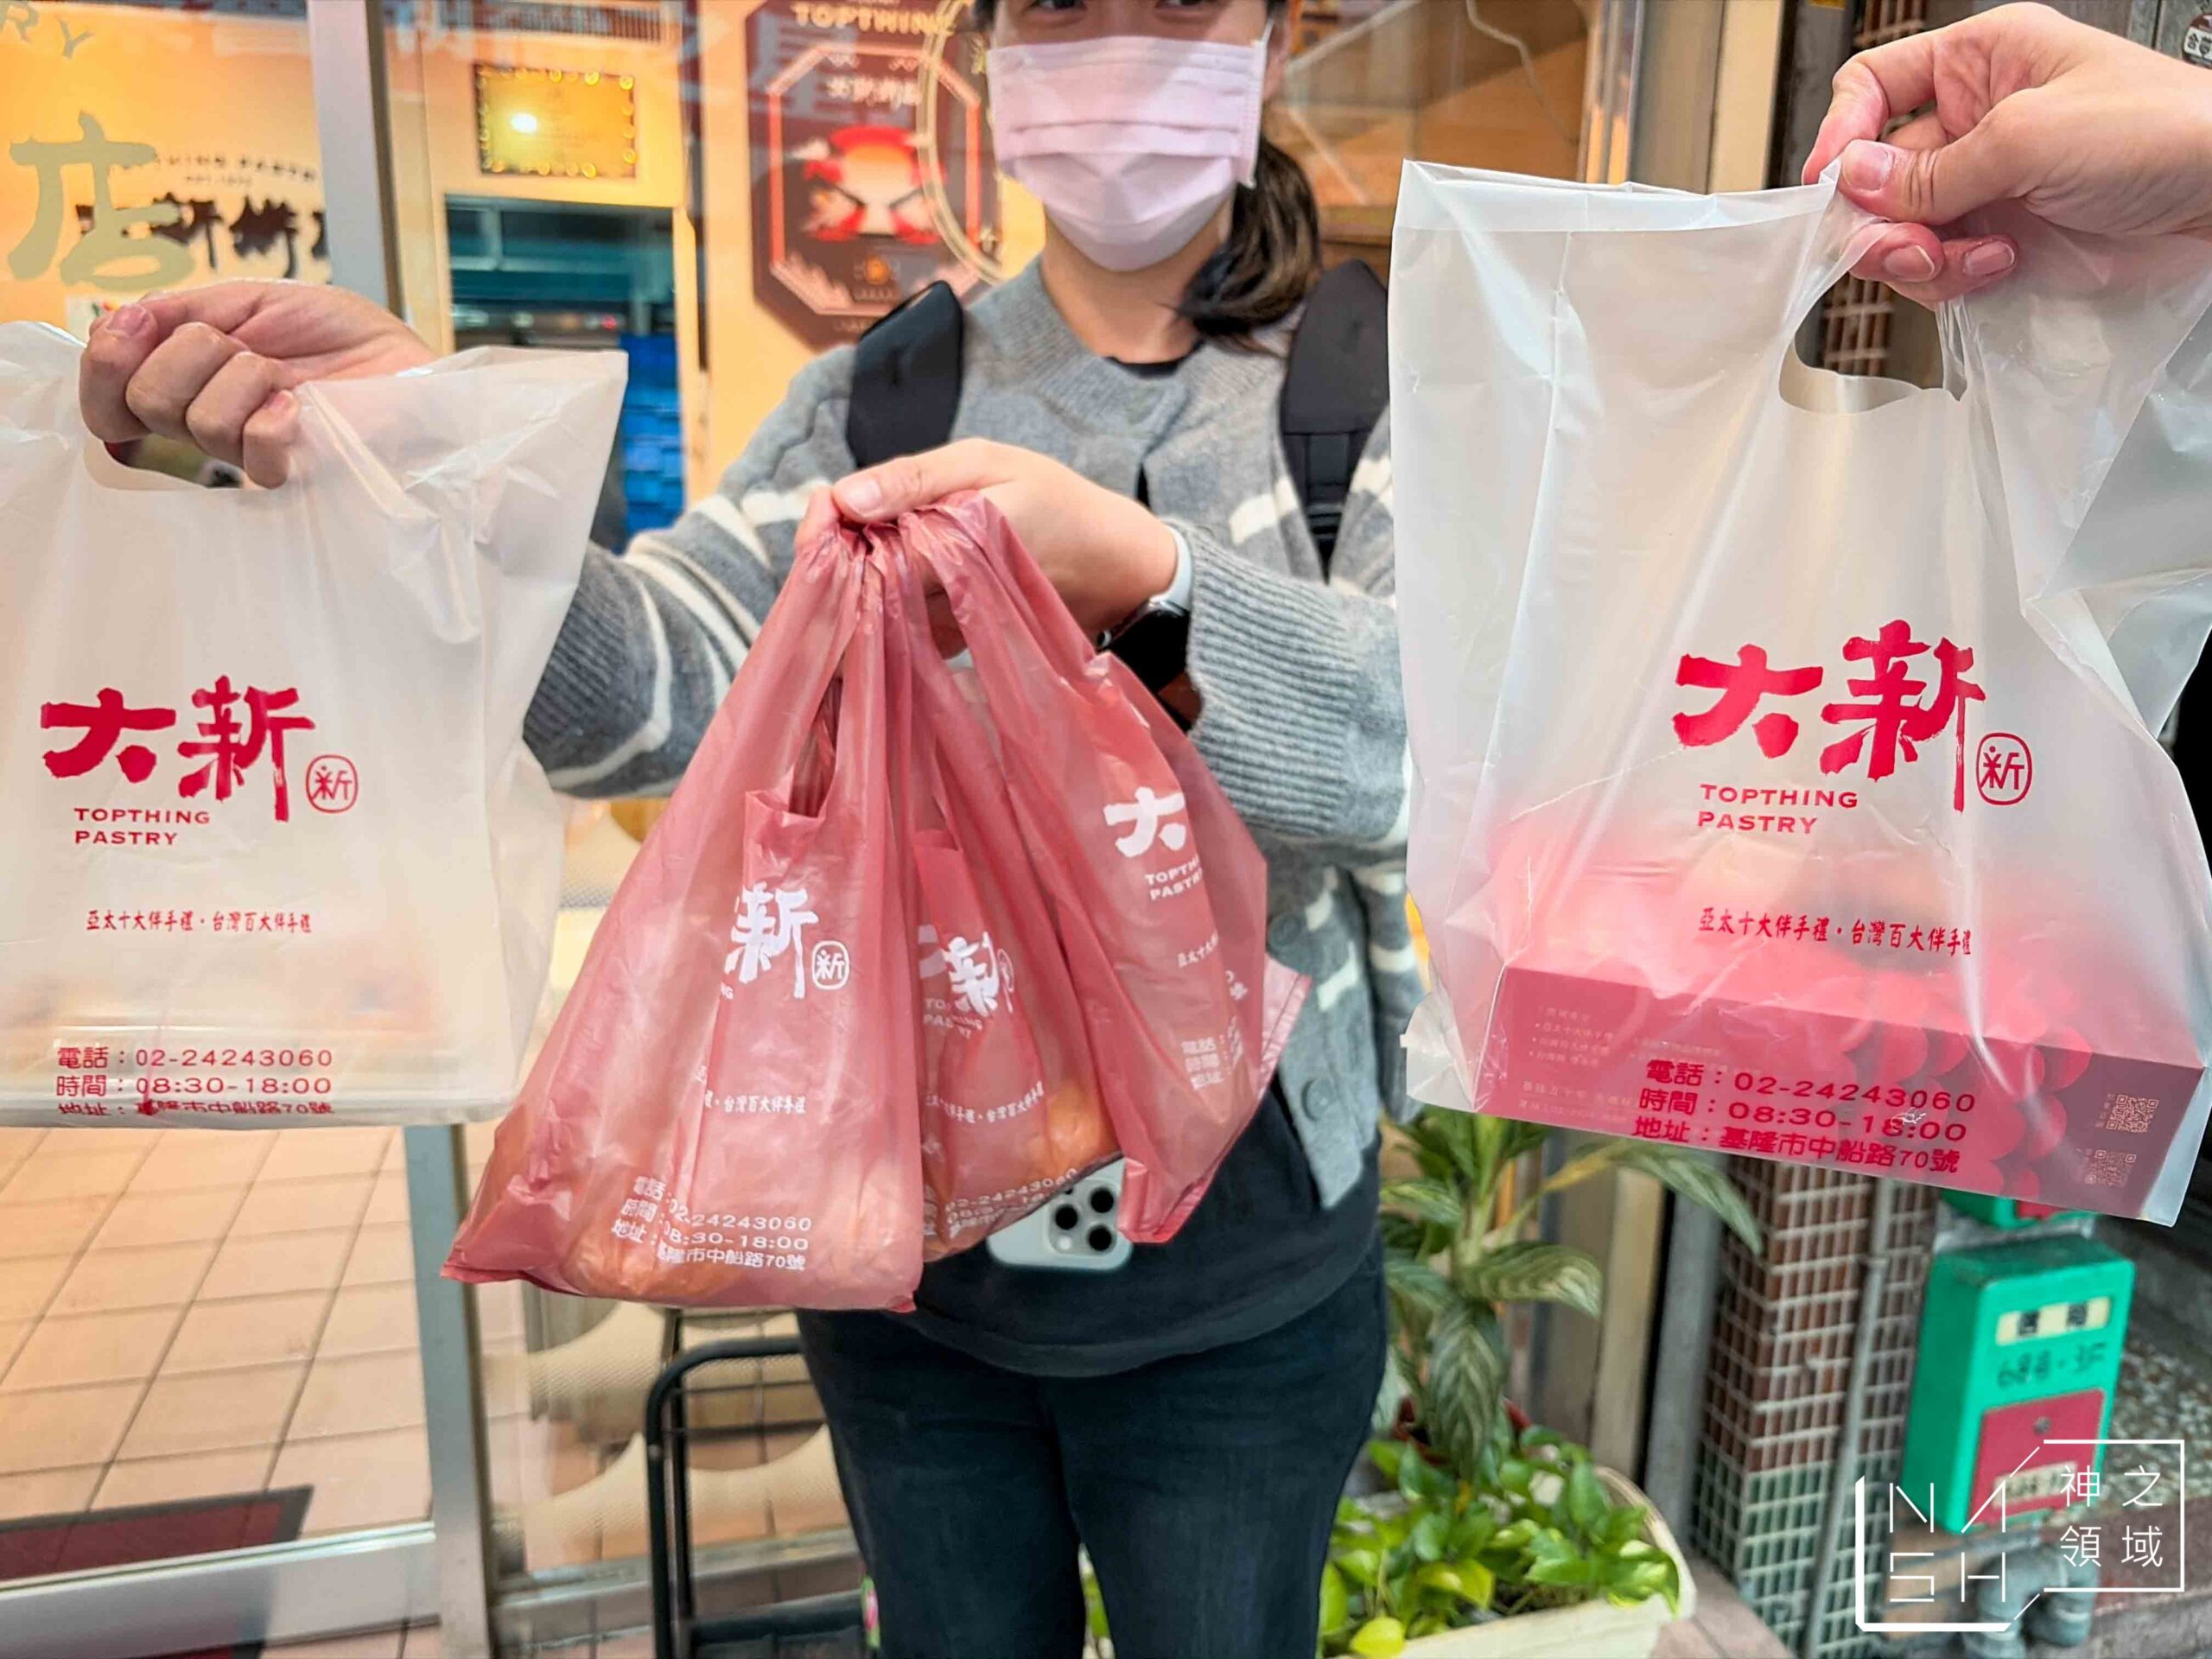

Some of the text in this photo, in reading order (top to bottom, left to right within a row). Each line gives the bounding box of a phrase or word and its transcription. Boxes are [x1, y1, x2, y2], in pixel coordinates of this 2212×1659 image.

[9, 111, 192, 290] 店
[1672, 619, 1986, 812] 大新
[40, 674, 315, 823] 大新
[73, 808, 211, 825] TOPTHING
[1700, 784, 1859, 810] TOPTHING
[74, 830, 178, 846] PASTRY
[1103, 786, 1187, 858] 大
[1697, 810, 1818, 835] PASTRY
